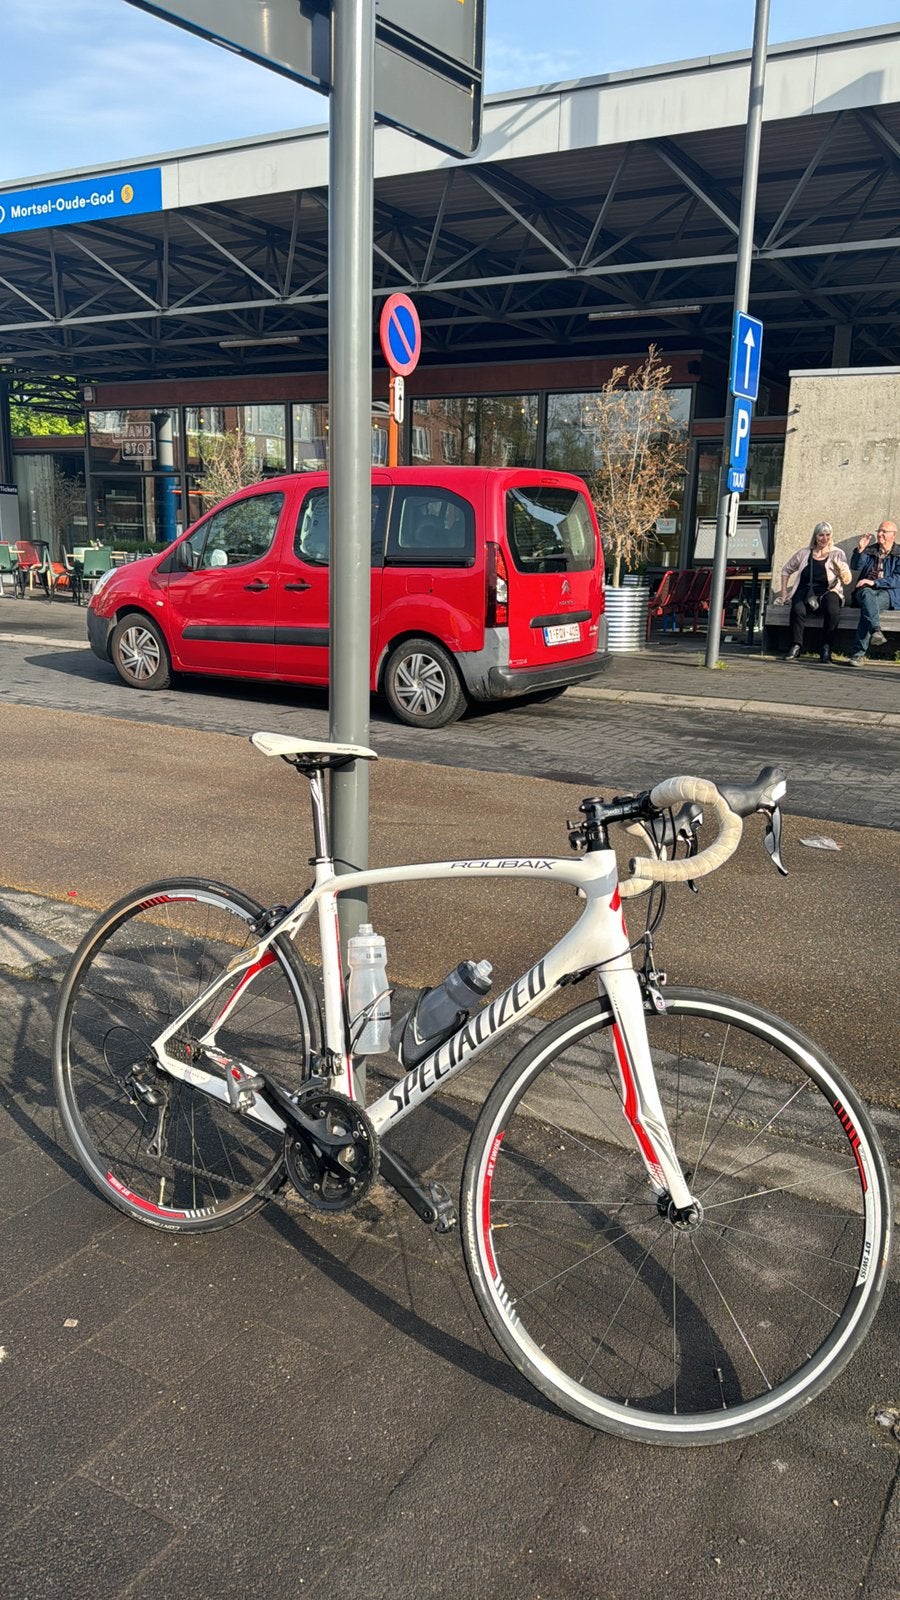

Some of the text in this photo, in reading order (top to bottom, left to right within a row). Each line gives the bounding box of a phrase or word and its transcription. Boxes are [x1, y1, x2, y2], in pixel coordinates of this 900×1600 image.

[11, 190, 114, 218] Mortsel-Oude-God
[125, 443, 152, 454] STOP
[735, 409, 749, 457] P
[732, 472, 745, 487] TAXI
[450, 860, 557, 870] ROUBAIX
[388, 959, 546, 1119] SPECIALIZED
[467, 1189, 481, 1277] CONTINENTAL
[860, 1241, 871, 1279] DT SWISS
